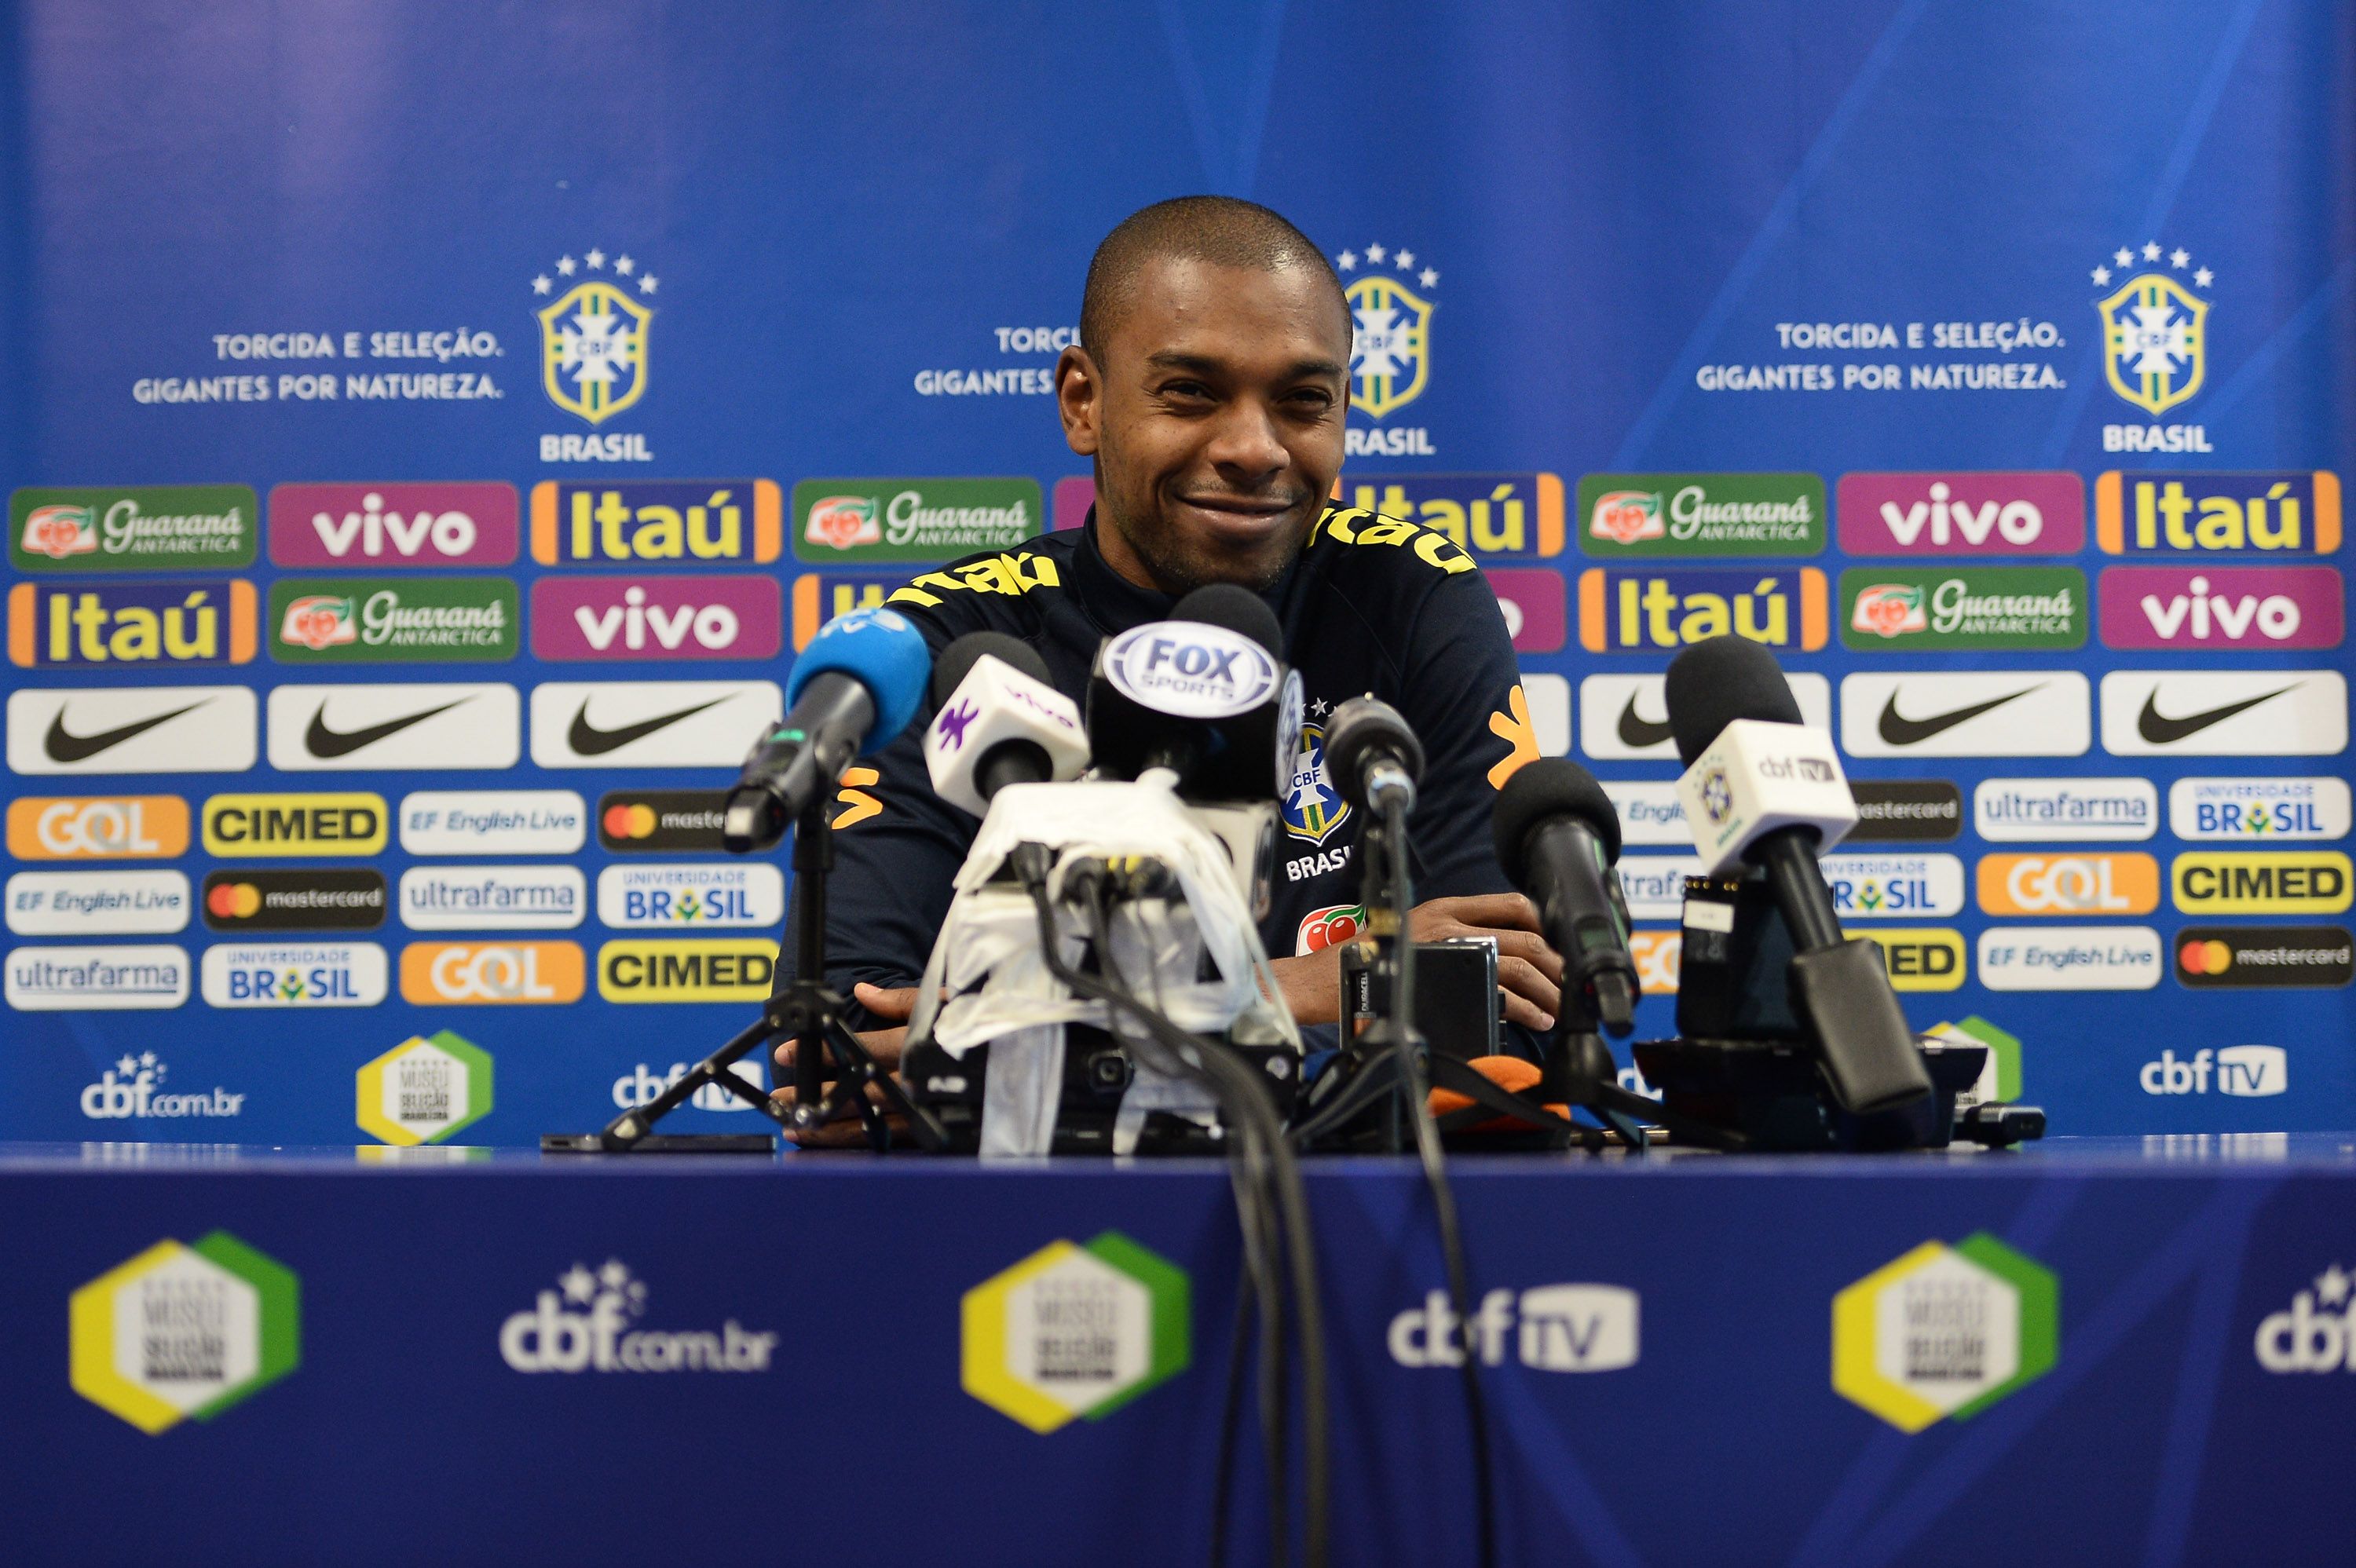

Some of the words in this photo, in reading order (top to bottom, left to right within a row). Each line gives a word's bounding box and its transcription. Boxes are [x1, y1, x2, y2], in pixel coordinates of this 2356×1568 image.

[212, 333, 336, 360] TORCIDA
[343, 332, 361, 359] E
[369, 327, 504, 363] SELEÇÃO.
[993, 327, 1082, 353] TORCI
[1776, 322, 1899, 350] TORCIDA
[1907, 322, 1924, 349] E
[1931, 317, 2067, 353] SELEÇÃO.
[133, 375, 269, 404] GIGANTES
[279, 375, 338, 401] POR
[346, 373, 504, 400] NATUREZA.
[913, 367, 1055, 396] GIGANTES
[1696, 364, 1835, 393] GIGANTES
[1842, 364, 1902, 391] POR
[1910, 363, 2067, 391] NATUREZA.
[540, 433, 653, 462] BRASIL
[1344, 427, 1437, 456] RASIL
[2102, 424, 2214, 453] BRASIL
[102, 499, 243, 553] Guaraná
[313, 492, 476, 557] vivo
[572, 490, 741, 559] Itaú
[886, 490, 1028, 546] Guaraná
[1670, 484, 1815, 540] Guaraná
[1881, 481, 2043, 546] vivo
[2135, 481, 2301, 551] Itaú
[133, 535, 240, 554] ANTARCTICA
[913, 528, 1026, 547] ANTARCTICA
[1698, 521, 1809, 542] ANTARCTICA
[361, 590, 504, 645] Guaraná
[574, 586, 738, 652] vivo
[1619, 577, 1789, 647] Itaú
[1932, 578, 2076, 633] Guaraná
[2141, 576, 2301, 641] vivo
[49, 590, 217, 662] Itaú
[392, 627, 503, 647] ANTARCTICA
[1963, 615, 2071, 634] ANTARCTICA
[1146, 638, 1240, 683] FOX
[1140, 673, 1235, 700] SPORTS
[1292, 769, 1322, 788] CBF
[1758, 753, 1795, 780] cbf
[1986, 793, 2148, 820] ultrafarma
[2194, 784, 2314, 799] UNIVERSIDADE
[409, 810, 437, 832] EF
[445, 810, 526, 834] English
[529, 810, 577, 830] Live
[1859, 799, 1958, 818] astercard
[2198, 802, 2324, 833] BRASIL
[37, 801, 160, 853] GOL
[210, 807, 379, 843] CIMED
[622, 871, 747, 885] UNIVERSIDADE
[1286, 846, 1352, 883] BRASI
[1819, 860, 1926, 874] NIVERSIDADE
[265, 886, 382, 909] mastercard
[409, 878, 575, 909] ultrafarma
[1834, 879, 1936, 909] RASIL
[2007, 859, 2129, 910] GOL
[2180, 867, 2344, 899] CIMED
[14, 892, 44, 911] EF
[52, 890, 131, 914] English
[133, 890, 182, 910] Live
[627, 890, 755, 921] BRASIL
[226, 950, 351, 964] UNIVERSIDADE
[605, 952, 774, 988] CIMED
[1988, 948, 2016, 967] EF
[2025, 946, 2105, 970] English
[2108, 946, 2153, 966] Live
[2236, 944, 2351, 966] mastercard
[15, 959, 178, 989] ultrafarma
[229, 968, 359, 1000] BRASIL
[430, 948, 554, 1000] GOL
[2139, 1048, 2214, 1095] cbf
[79, 1071, 245, 1118] cbf.com.br
[499, 1289, 779, 1373] cbf.com.br
